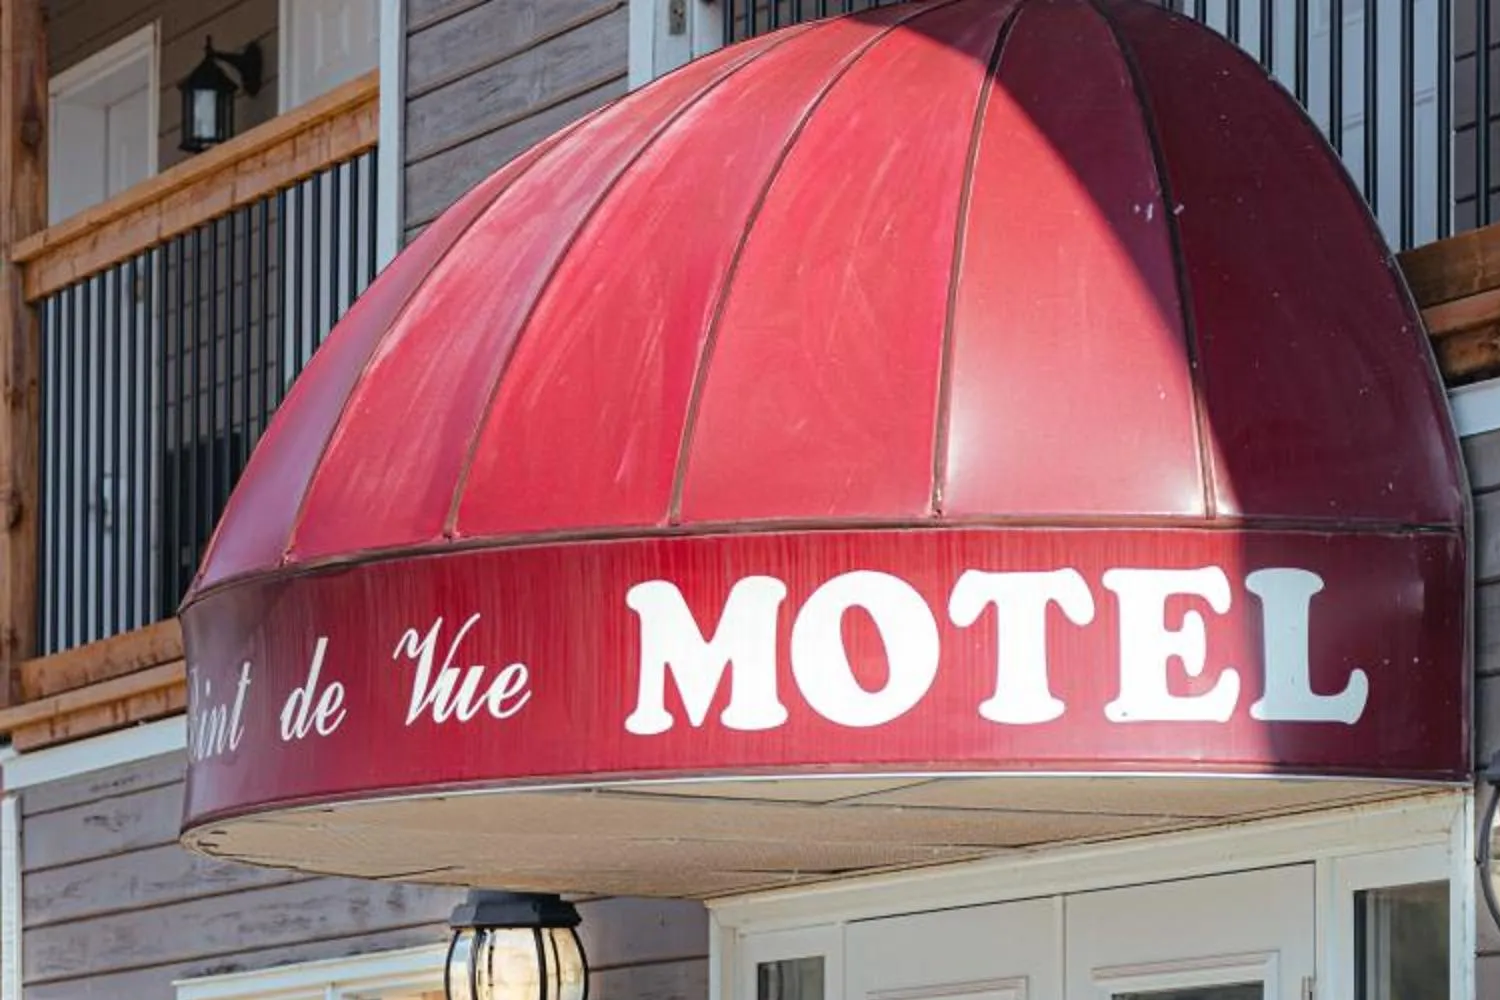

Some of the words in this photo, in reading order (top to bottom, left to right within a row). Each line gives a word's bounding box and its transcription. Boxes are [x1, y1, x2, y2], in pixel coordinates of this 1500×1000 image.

[279, 637, 347, 740] de
[393, 613, 531, 727] Vue
[624, 565, 1370, 736] MOTEL
